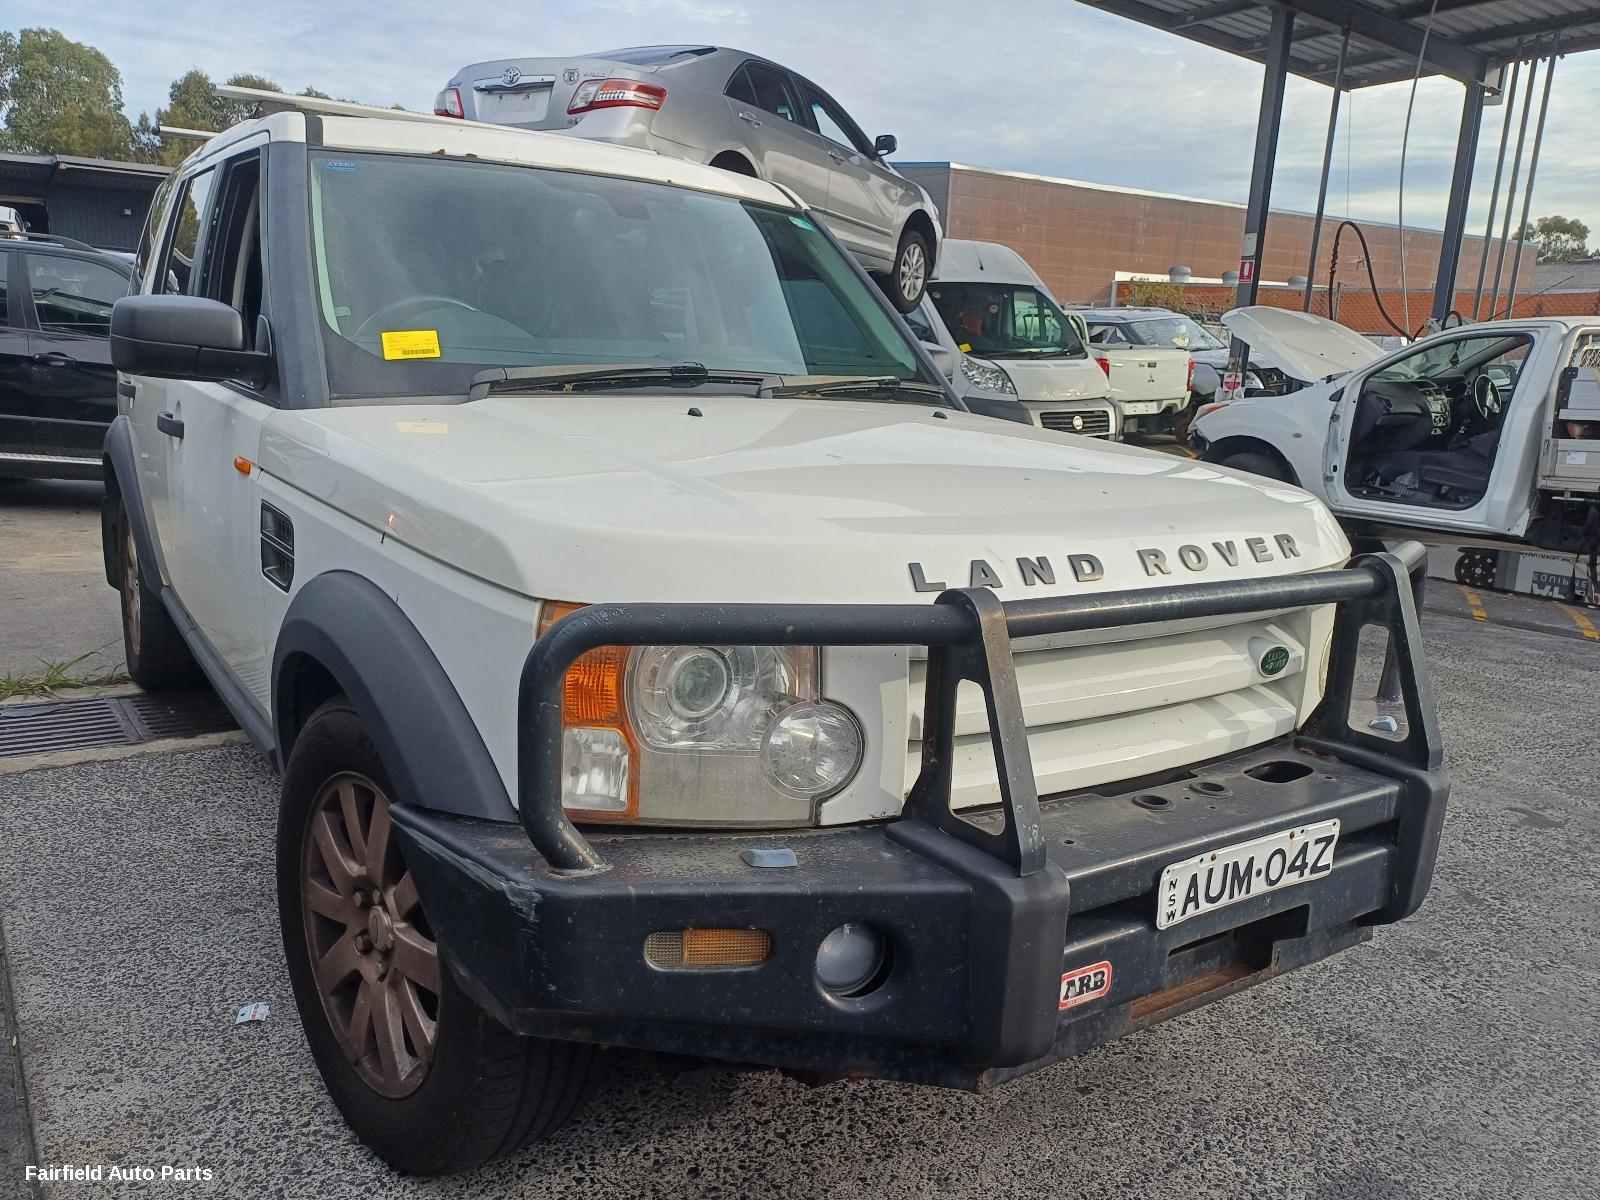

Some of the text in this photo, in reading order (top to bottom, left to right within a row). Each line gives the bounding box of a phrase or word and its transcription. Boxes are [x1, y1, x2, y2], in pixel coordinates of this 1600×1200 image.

[908, 532, 1302, 593] LAND ROVER
[1062, 970, 1106, 1001] ARB
